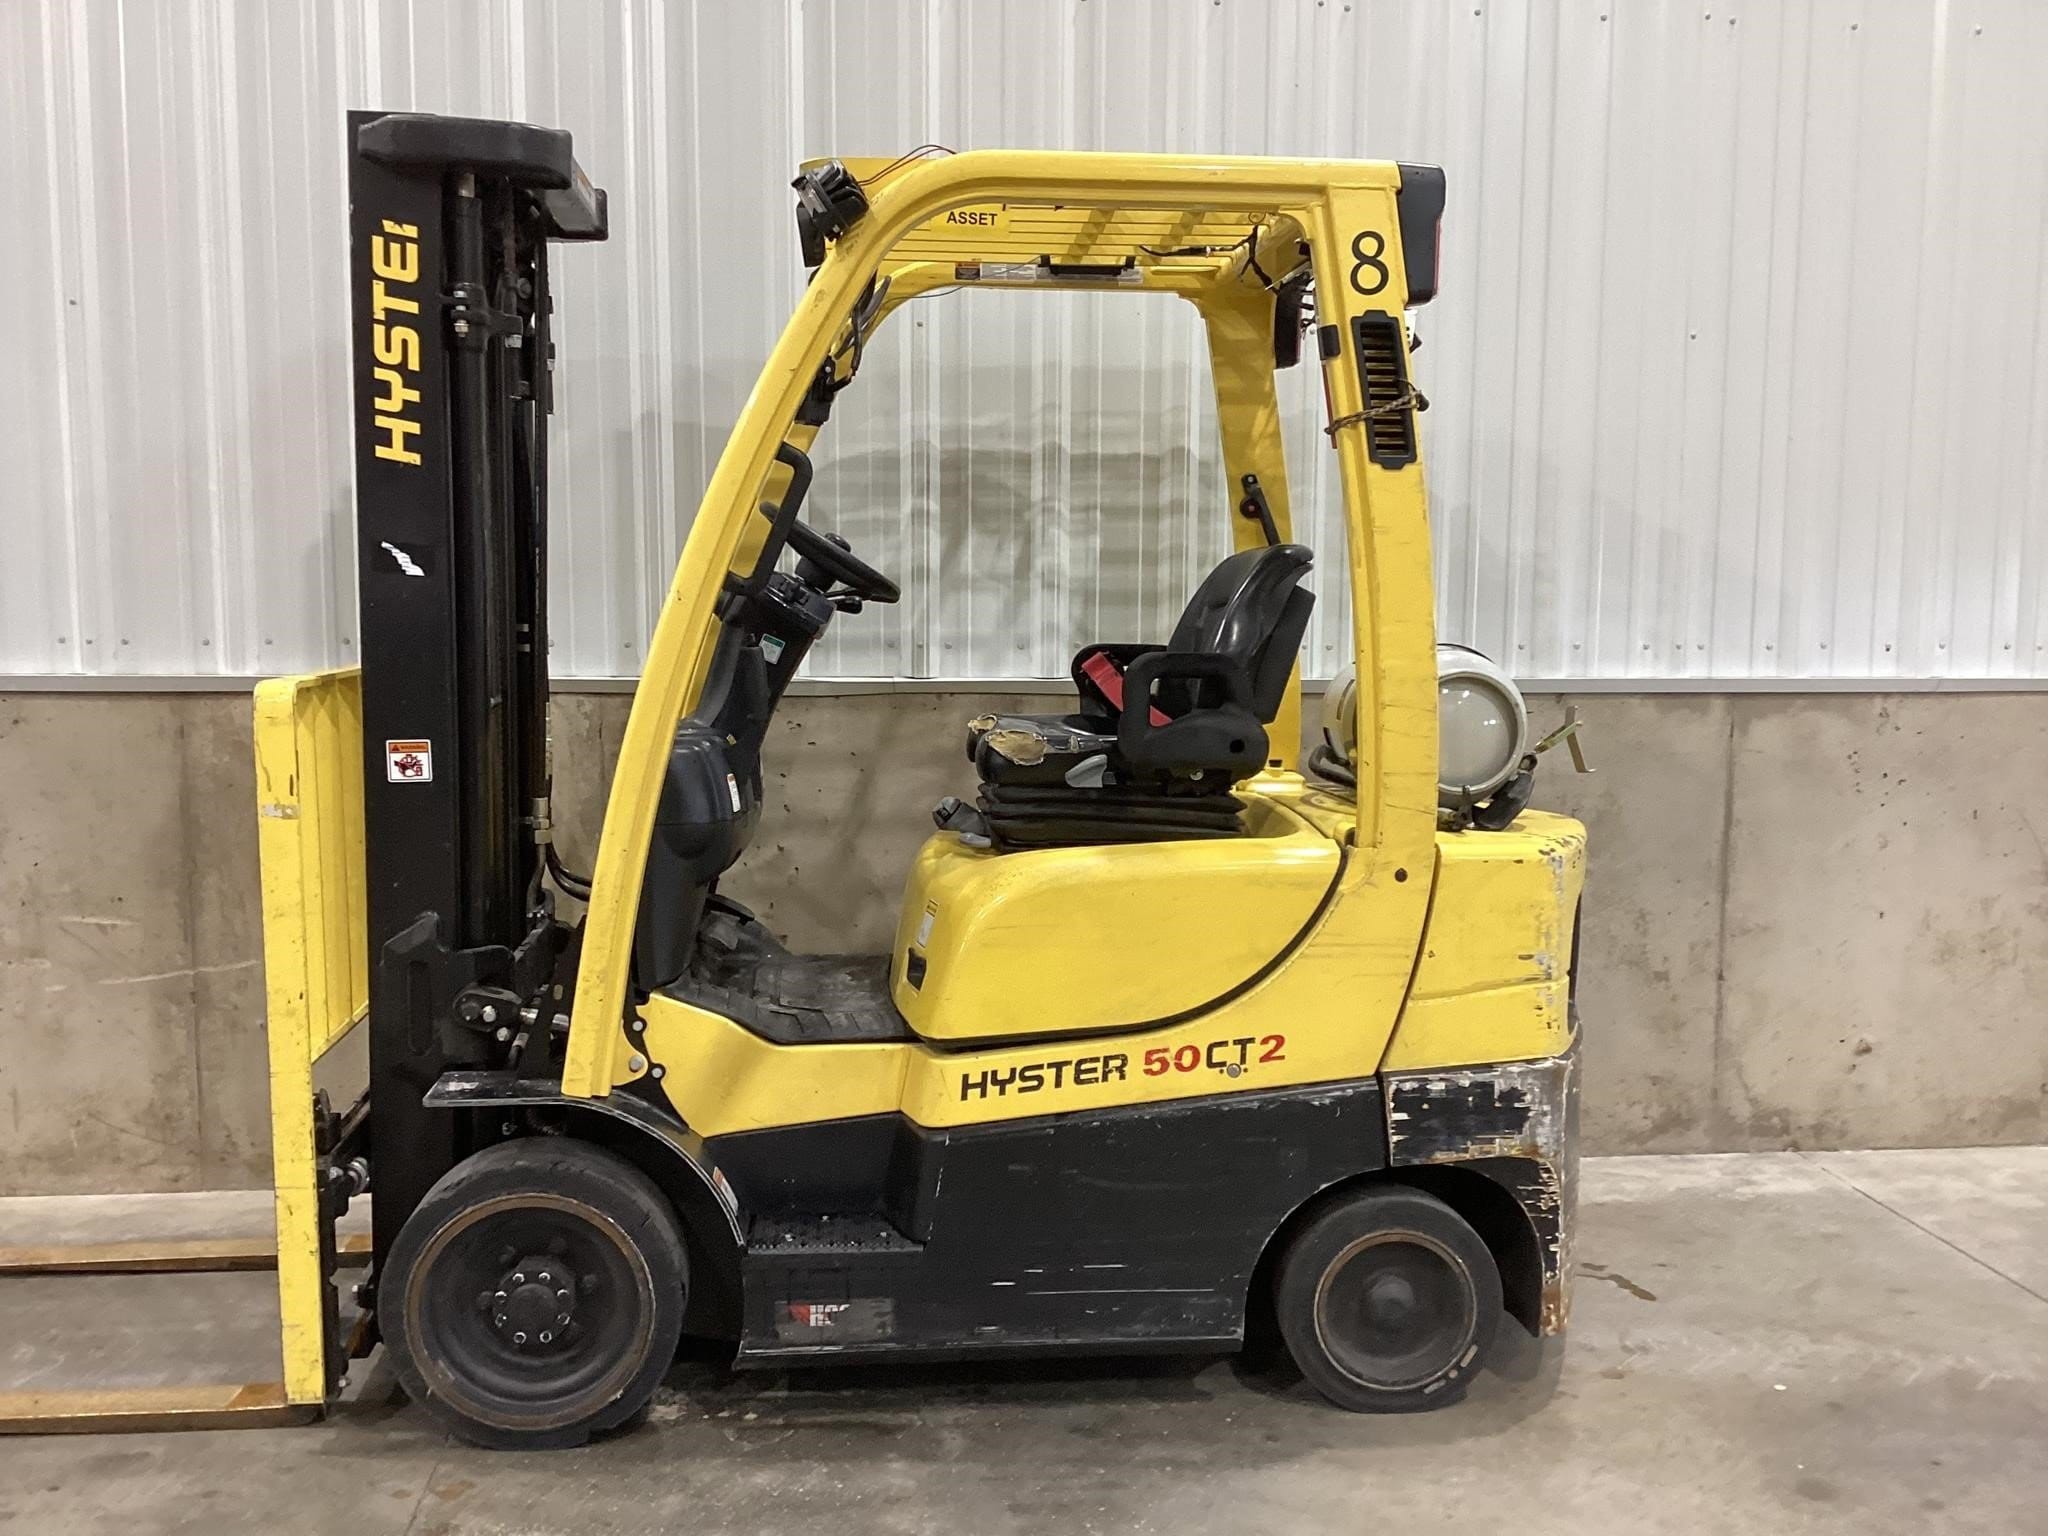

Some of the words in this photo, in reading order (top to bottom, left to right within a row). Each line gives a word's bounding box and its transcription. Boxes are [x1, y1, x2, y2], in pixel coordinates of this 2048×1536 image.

[946, 211, 998, 226] ASSET
[1350, 231, 1389, 296] 8
[960, 1053, 1129, 1101] HYSTER
